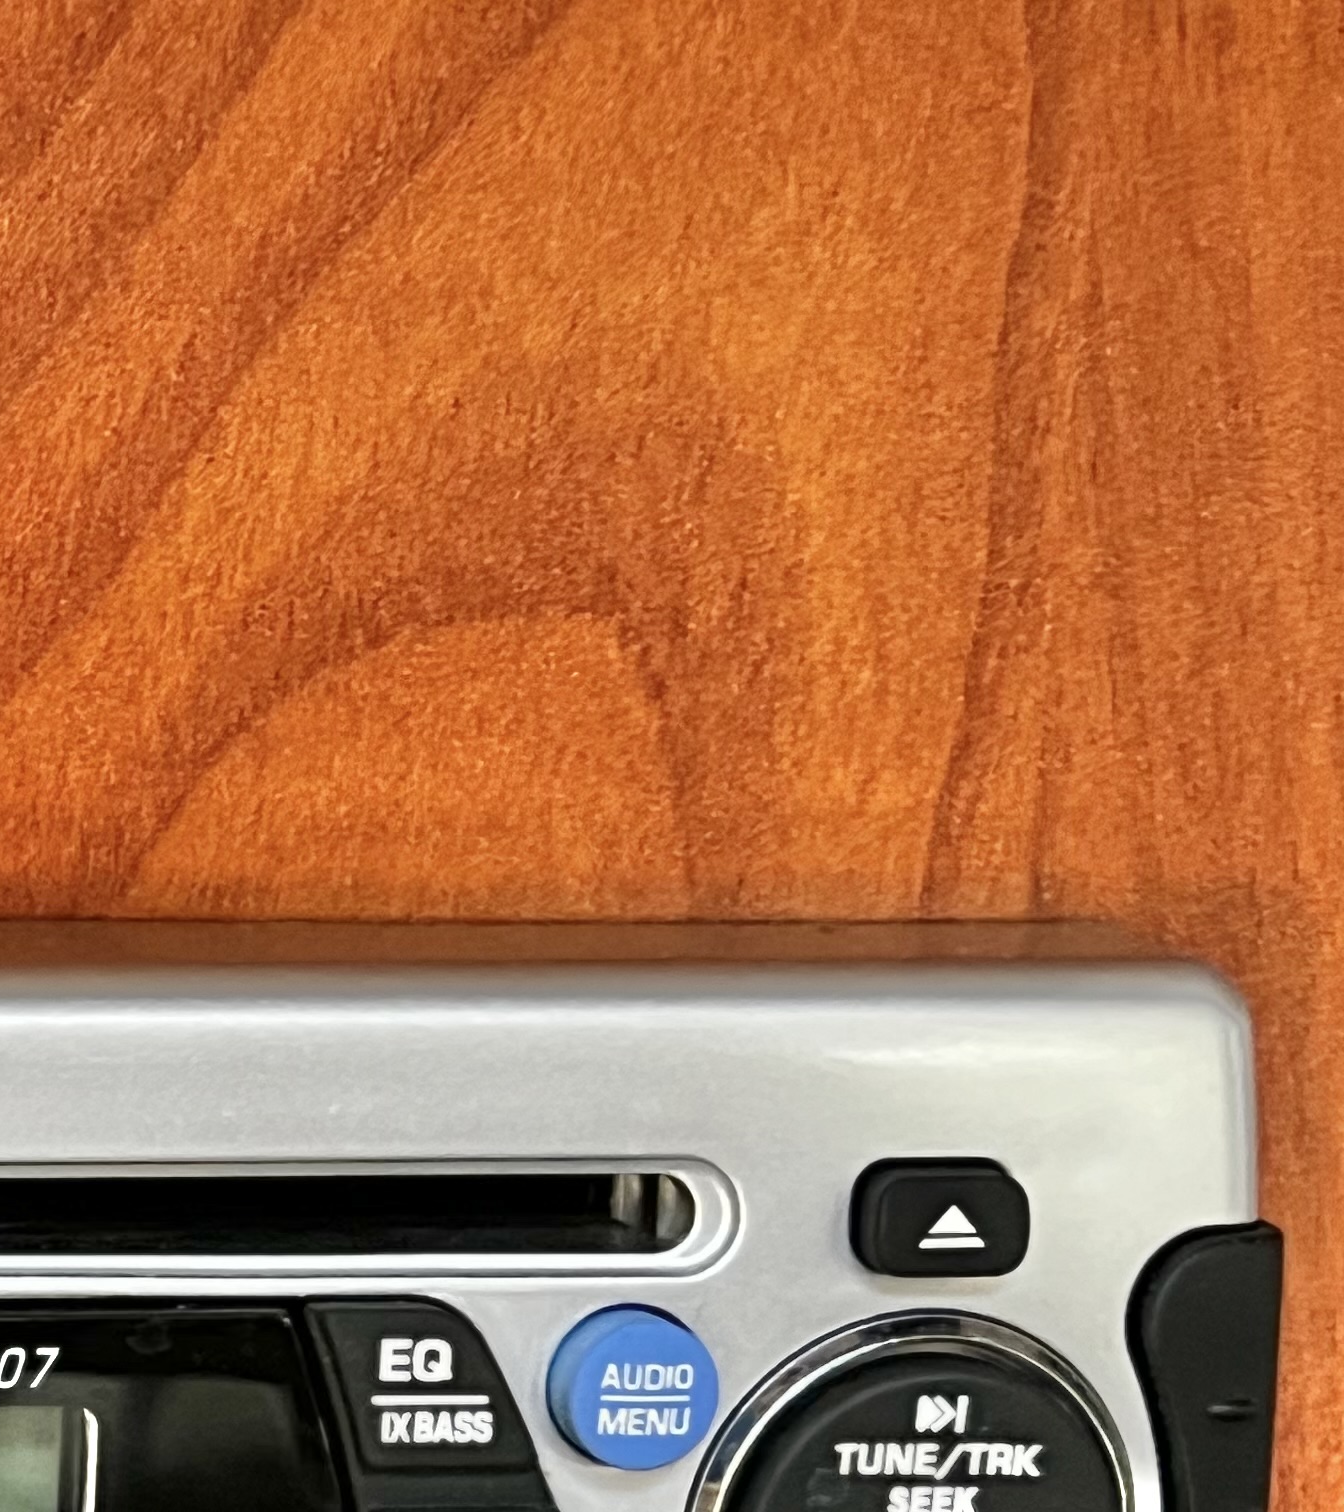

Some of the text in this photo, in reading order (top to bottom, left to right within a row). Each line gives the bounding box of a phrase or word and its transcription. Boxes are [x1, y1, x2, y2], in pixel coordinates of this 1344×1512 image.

[378, 1338, 453, 1383] EQ
[600, 1363, 694, 1391] AUDIO
[413, 1410, 494, 1444] BASS
[597, 1406, 691, 1436] MENU
[834, 1442, 1044, 1481] TUNE/TRK
